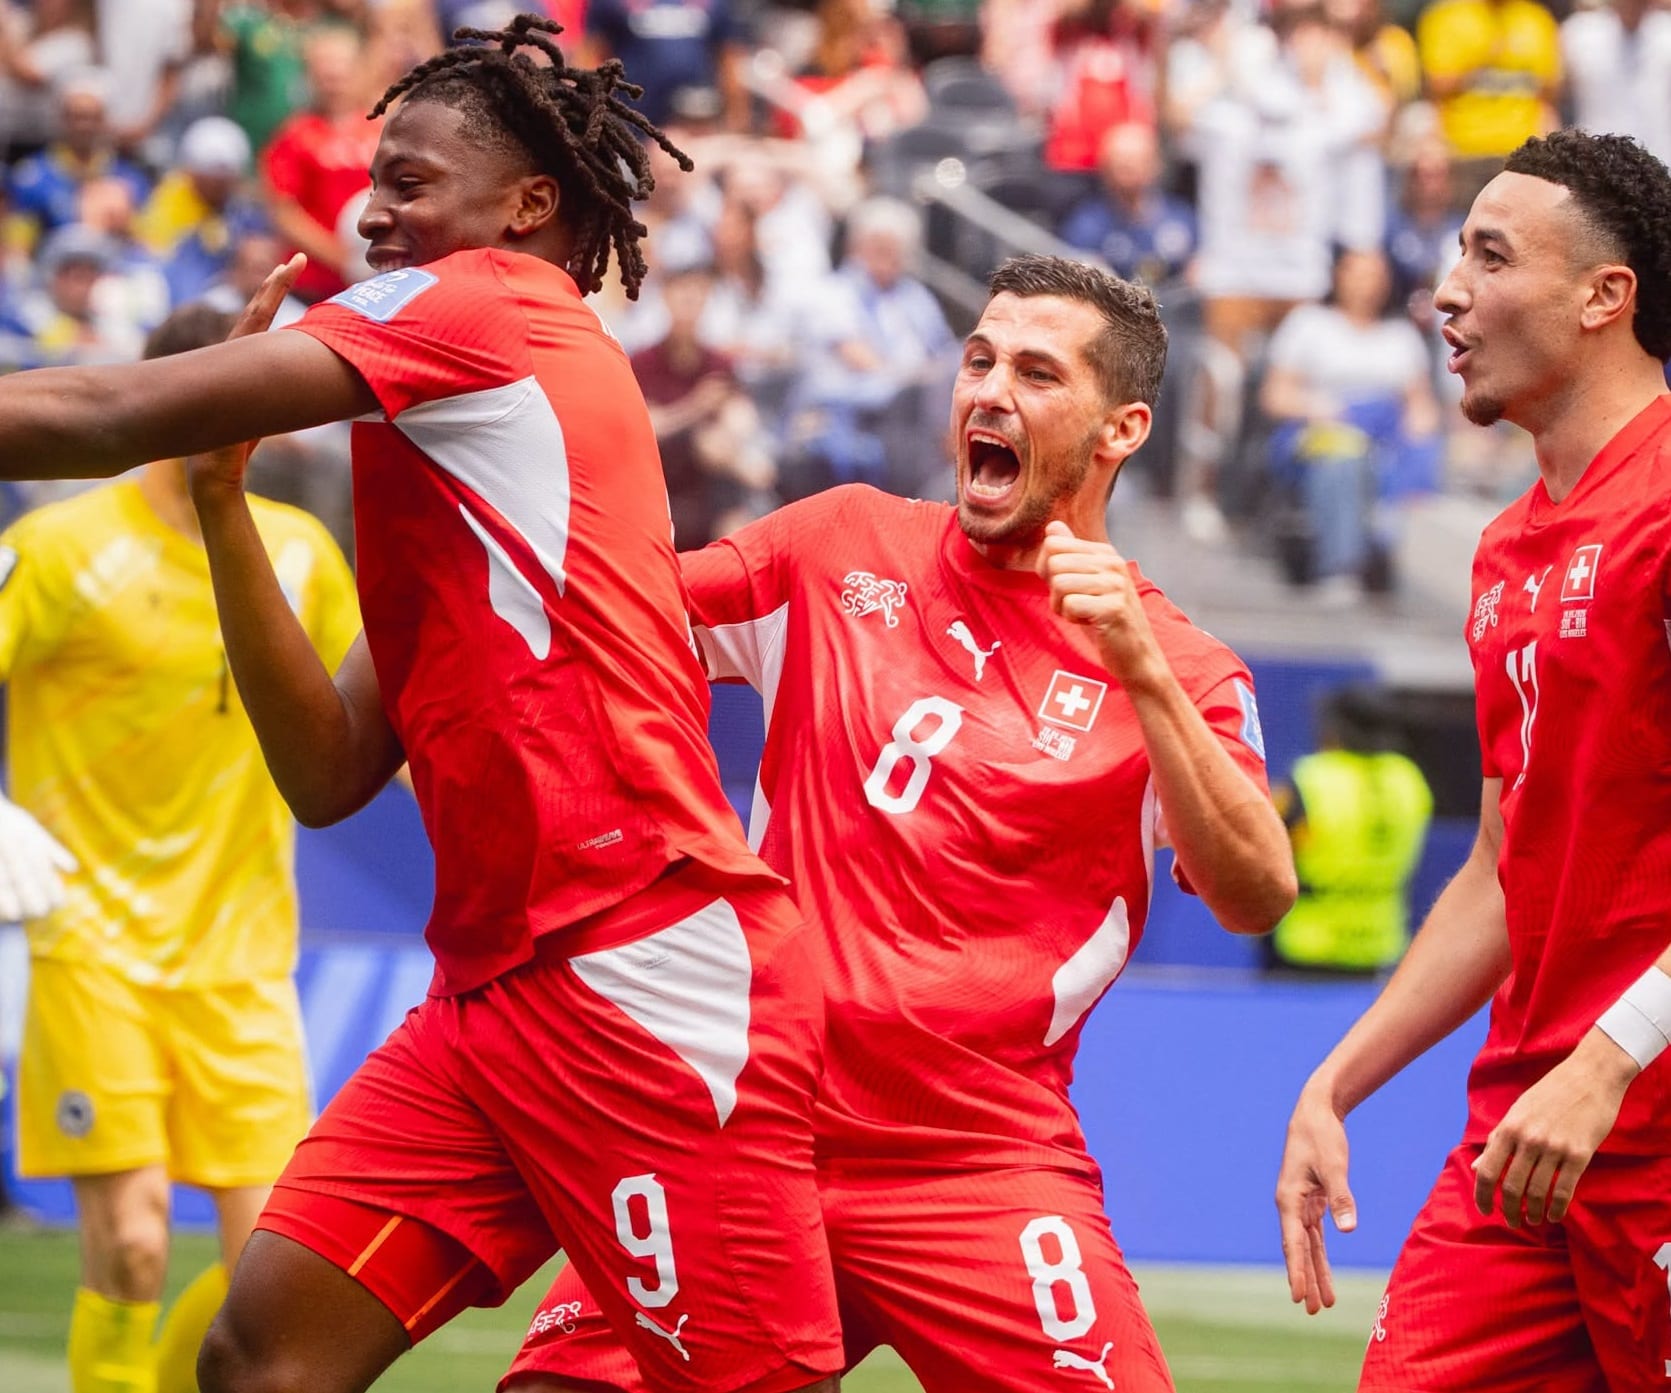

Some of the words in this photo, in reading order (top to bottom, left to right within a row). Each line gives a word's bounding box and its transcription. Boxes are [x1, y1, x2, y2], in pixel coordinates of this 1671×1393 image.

[863, 695, 965, 814] 8
[611, 1173, 679, 1308] 9
[1019, 1215, 1097, 1342] 8
